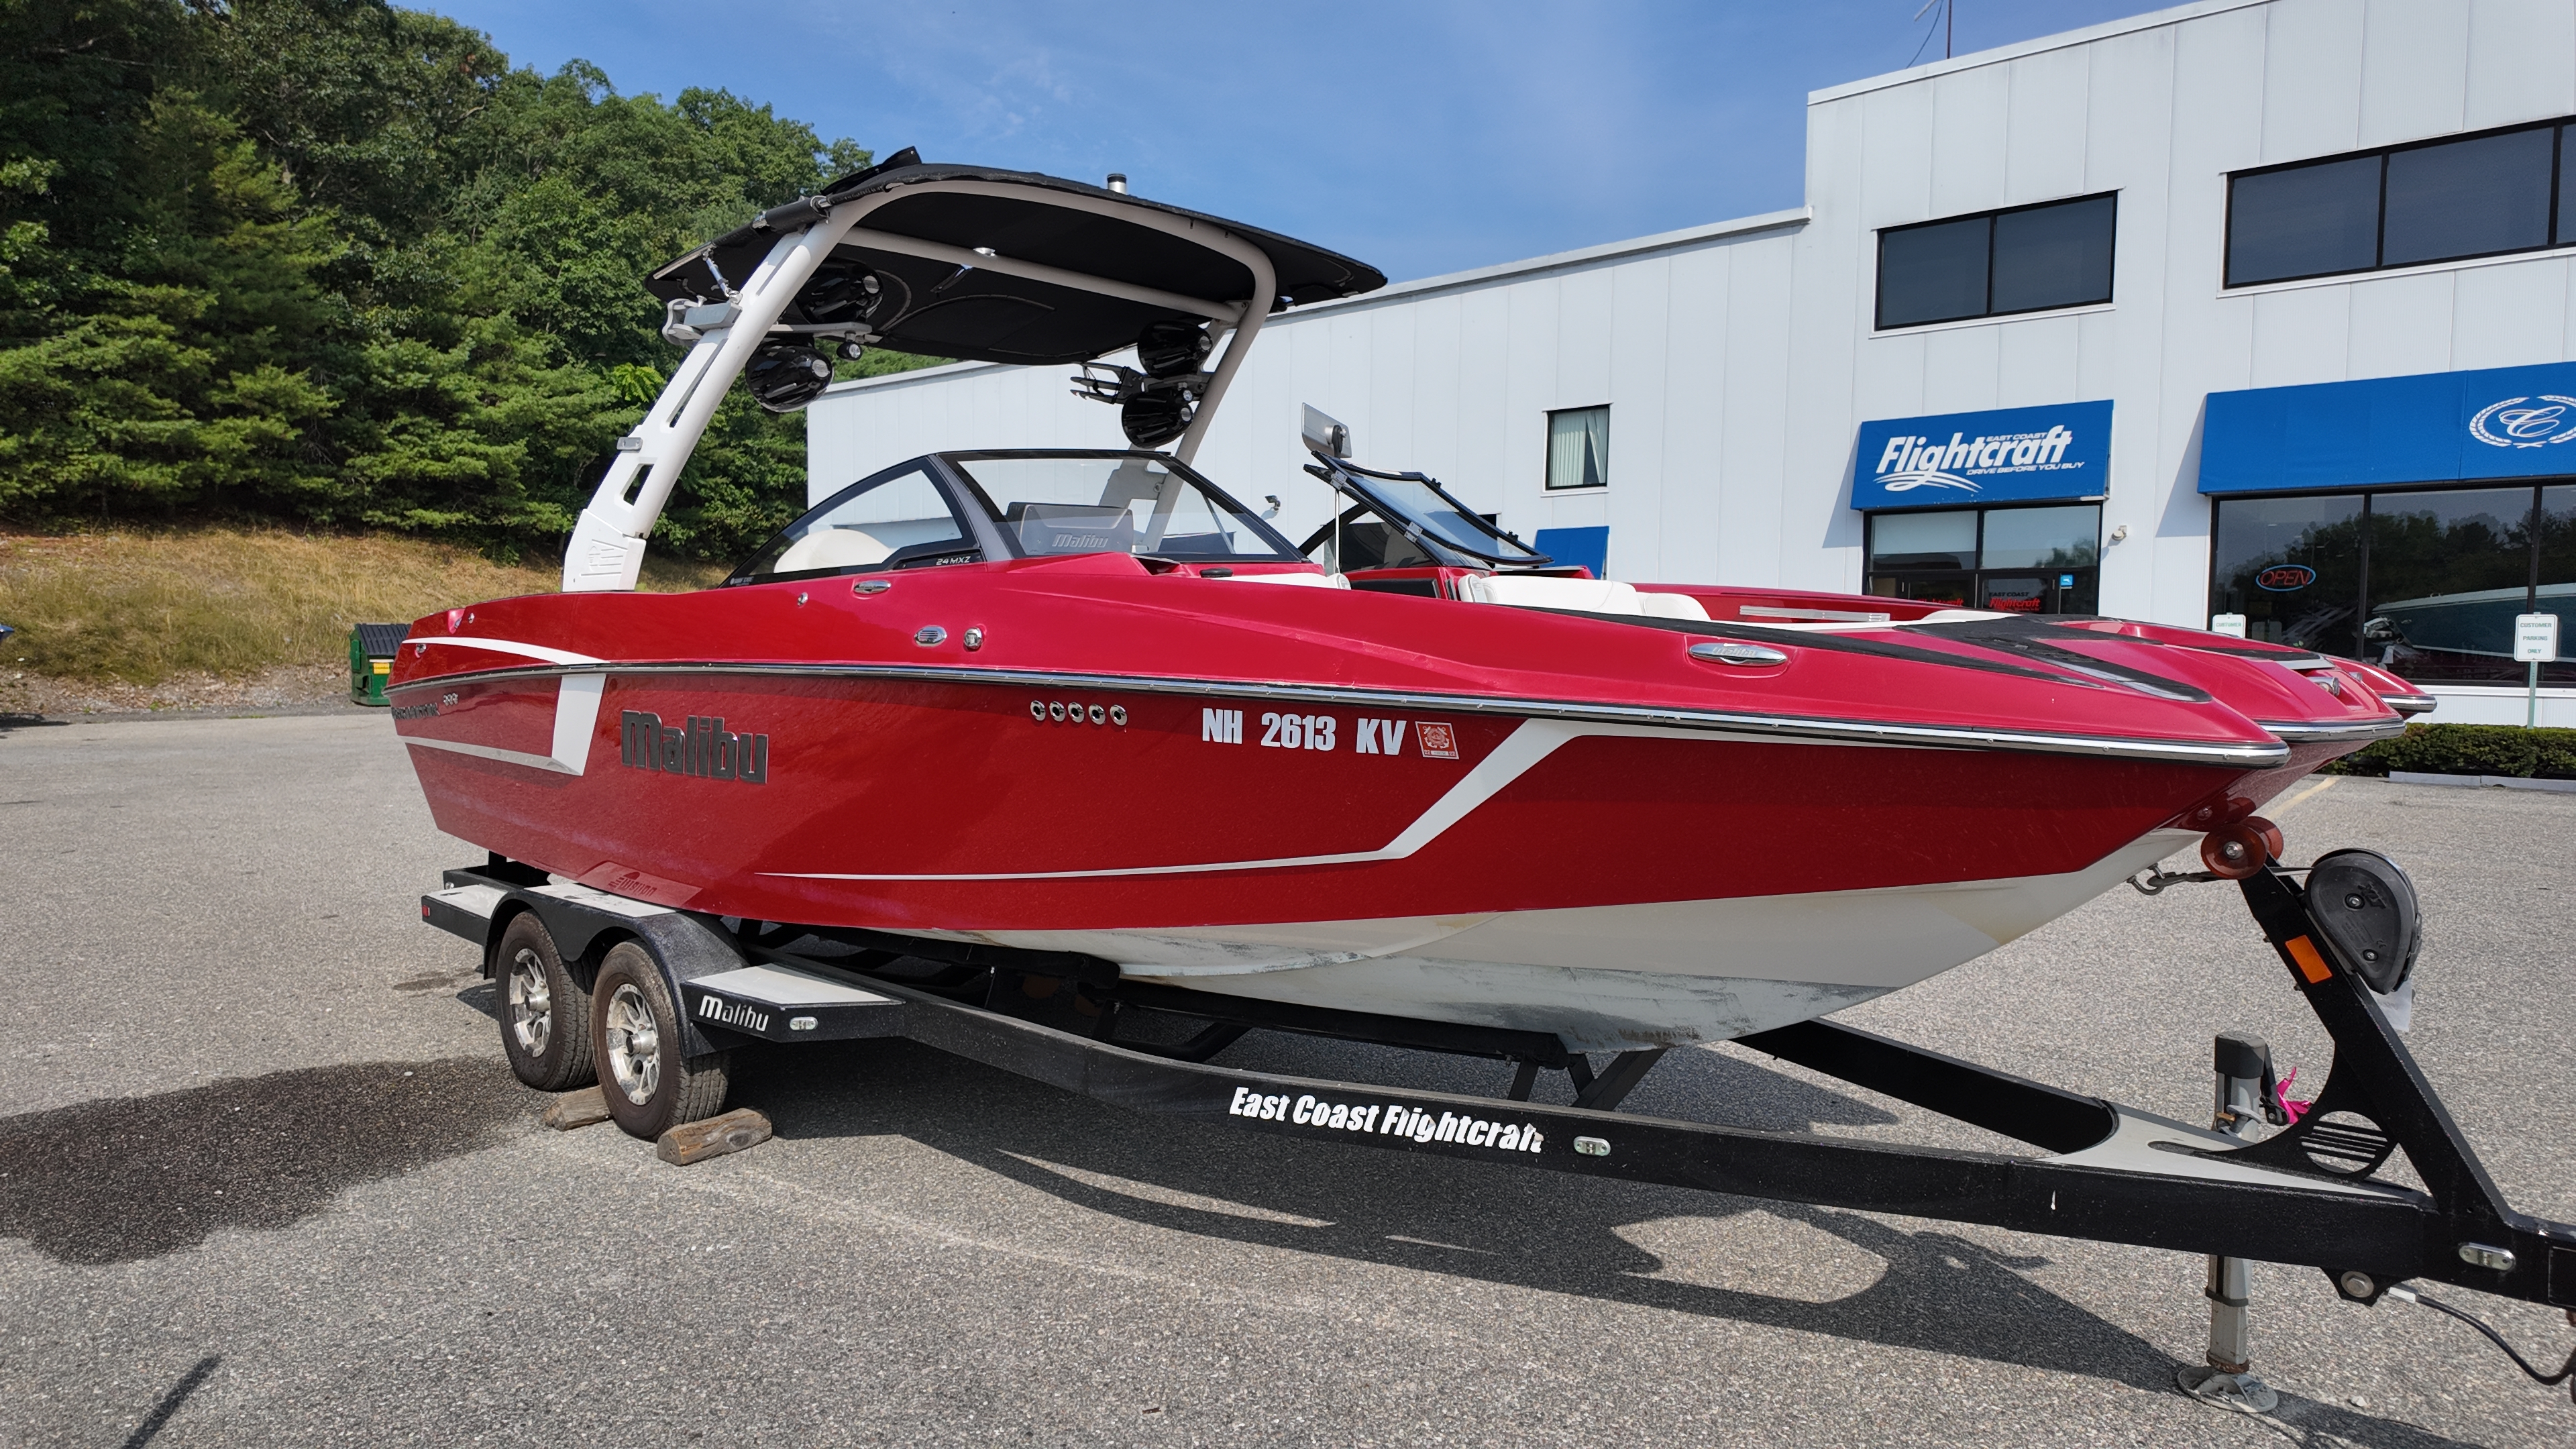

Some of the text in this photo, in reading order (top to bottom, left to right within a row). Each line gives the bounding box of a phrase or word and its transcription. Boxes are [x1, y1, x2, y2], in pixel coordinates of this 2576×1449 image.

[2012, 432, 2047, 441] COAST
[1876, 425, 2073, 491] Flightcraft
[1966, 461, 2084, 476] DRIVE BEFORE YOU BUY
[1052, 533, 1109, 548] Malibu
[2259, 570, 2311, 586] OPEN
[1989, 597, 2041, 610] Flightcraft
[1202, 708, 1407, 755] NH 2613 KV
[622, 709, 768, 784] Malibu
[698, 995, 769, 1032] Malibu
[1229, 1087, 1544, 1153] East Coast Flightcraft
